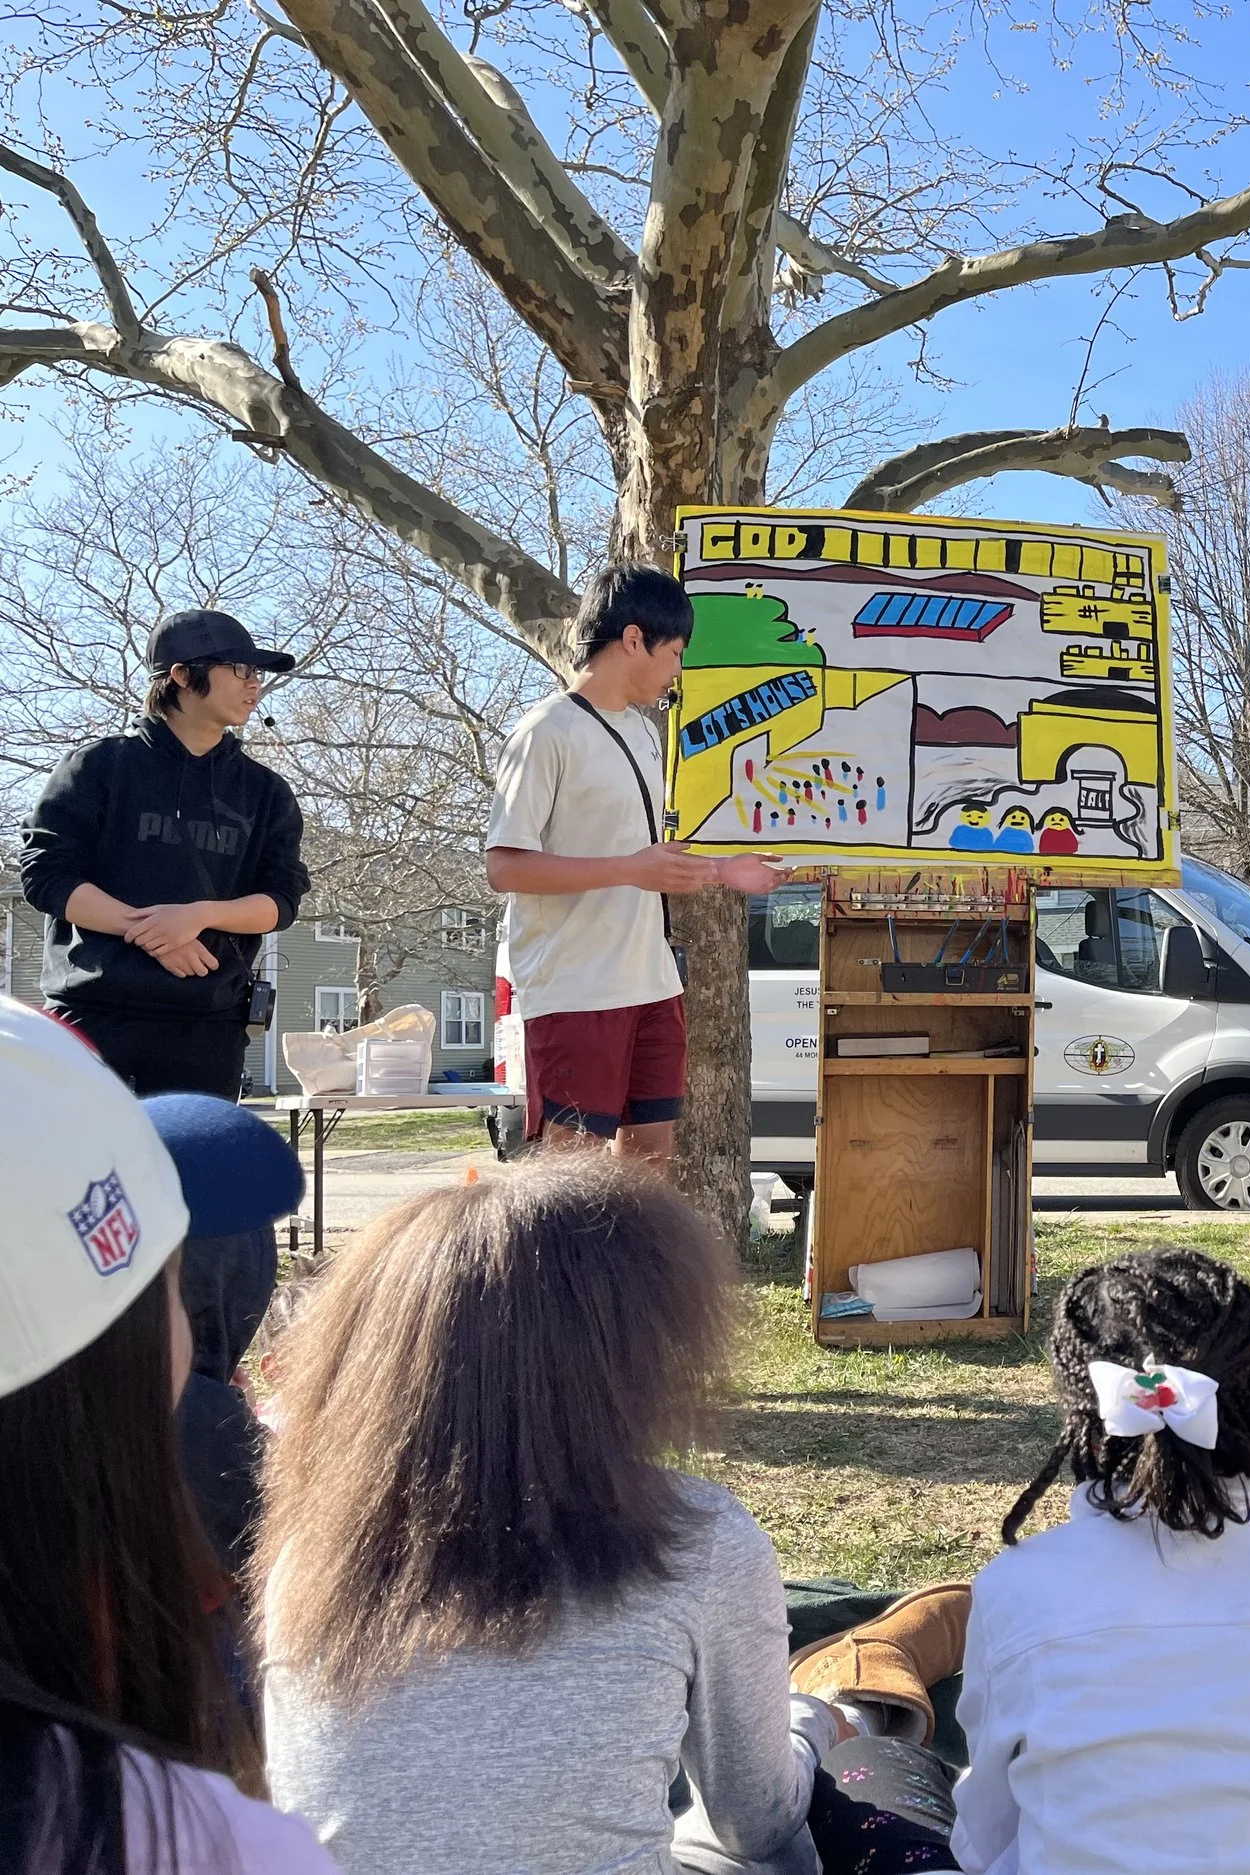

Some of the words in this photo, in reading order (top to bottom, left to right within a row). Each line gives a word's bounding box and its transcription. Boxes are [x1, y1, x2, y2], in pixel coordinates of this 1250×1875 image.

[702, 522, 808, 560] GOD
[680, 697, 751, 761] LOT'S
[744, 670, 816, 724] HOUSE
[1079, 788, 1111, 809] SALT
[796, 1001, 814, 1009] THE
[785, 1038, 818, 1048] OPEN
[89, 1206, 137, 1268] NFL
